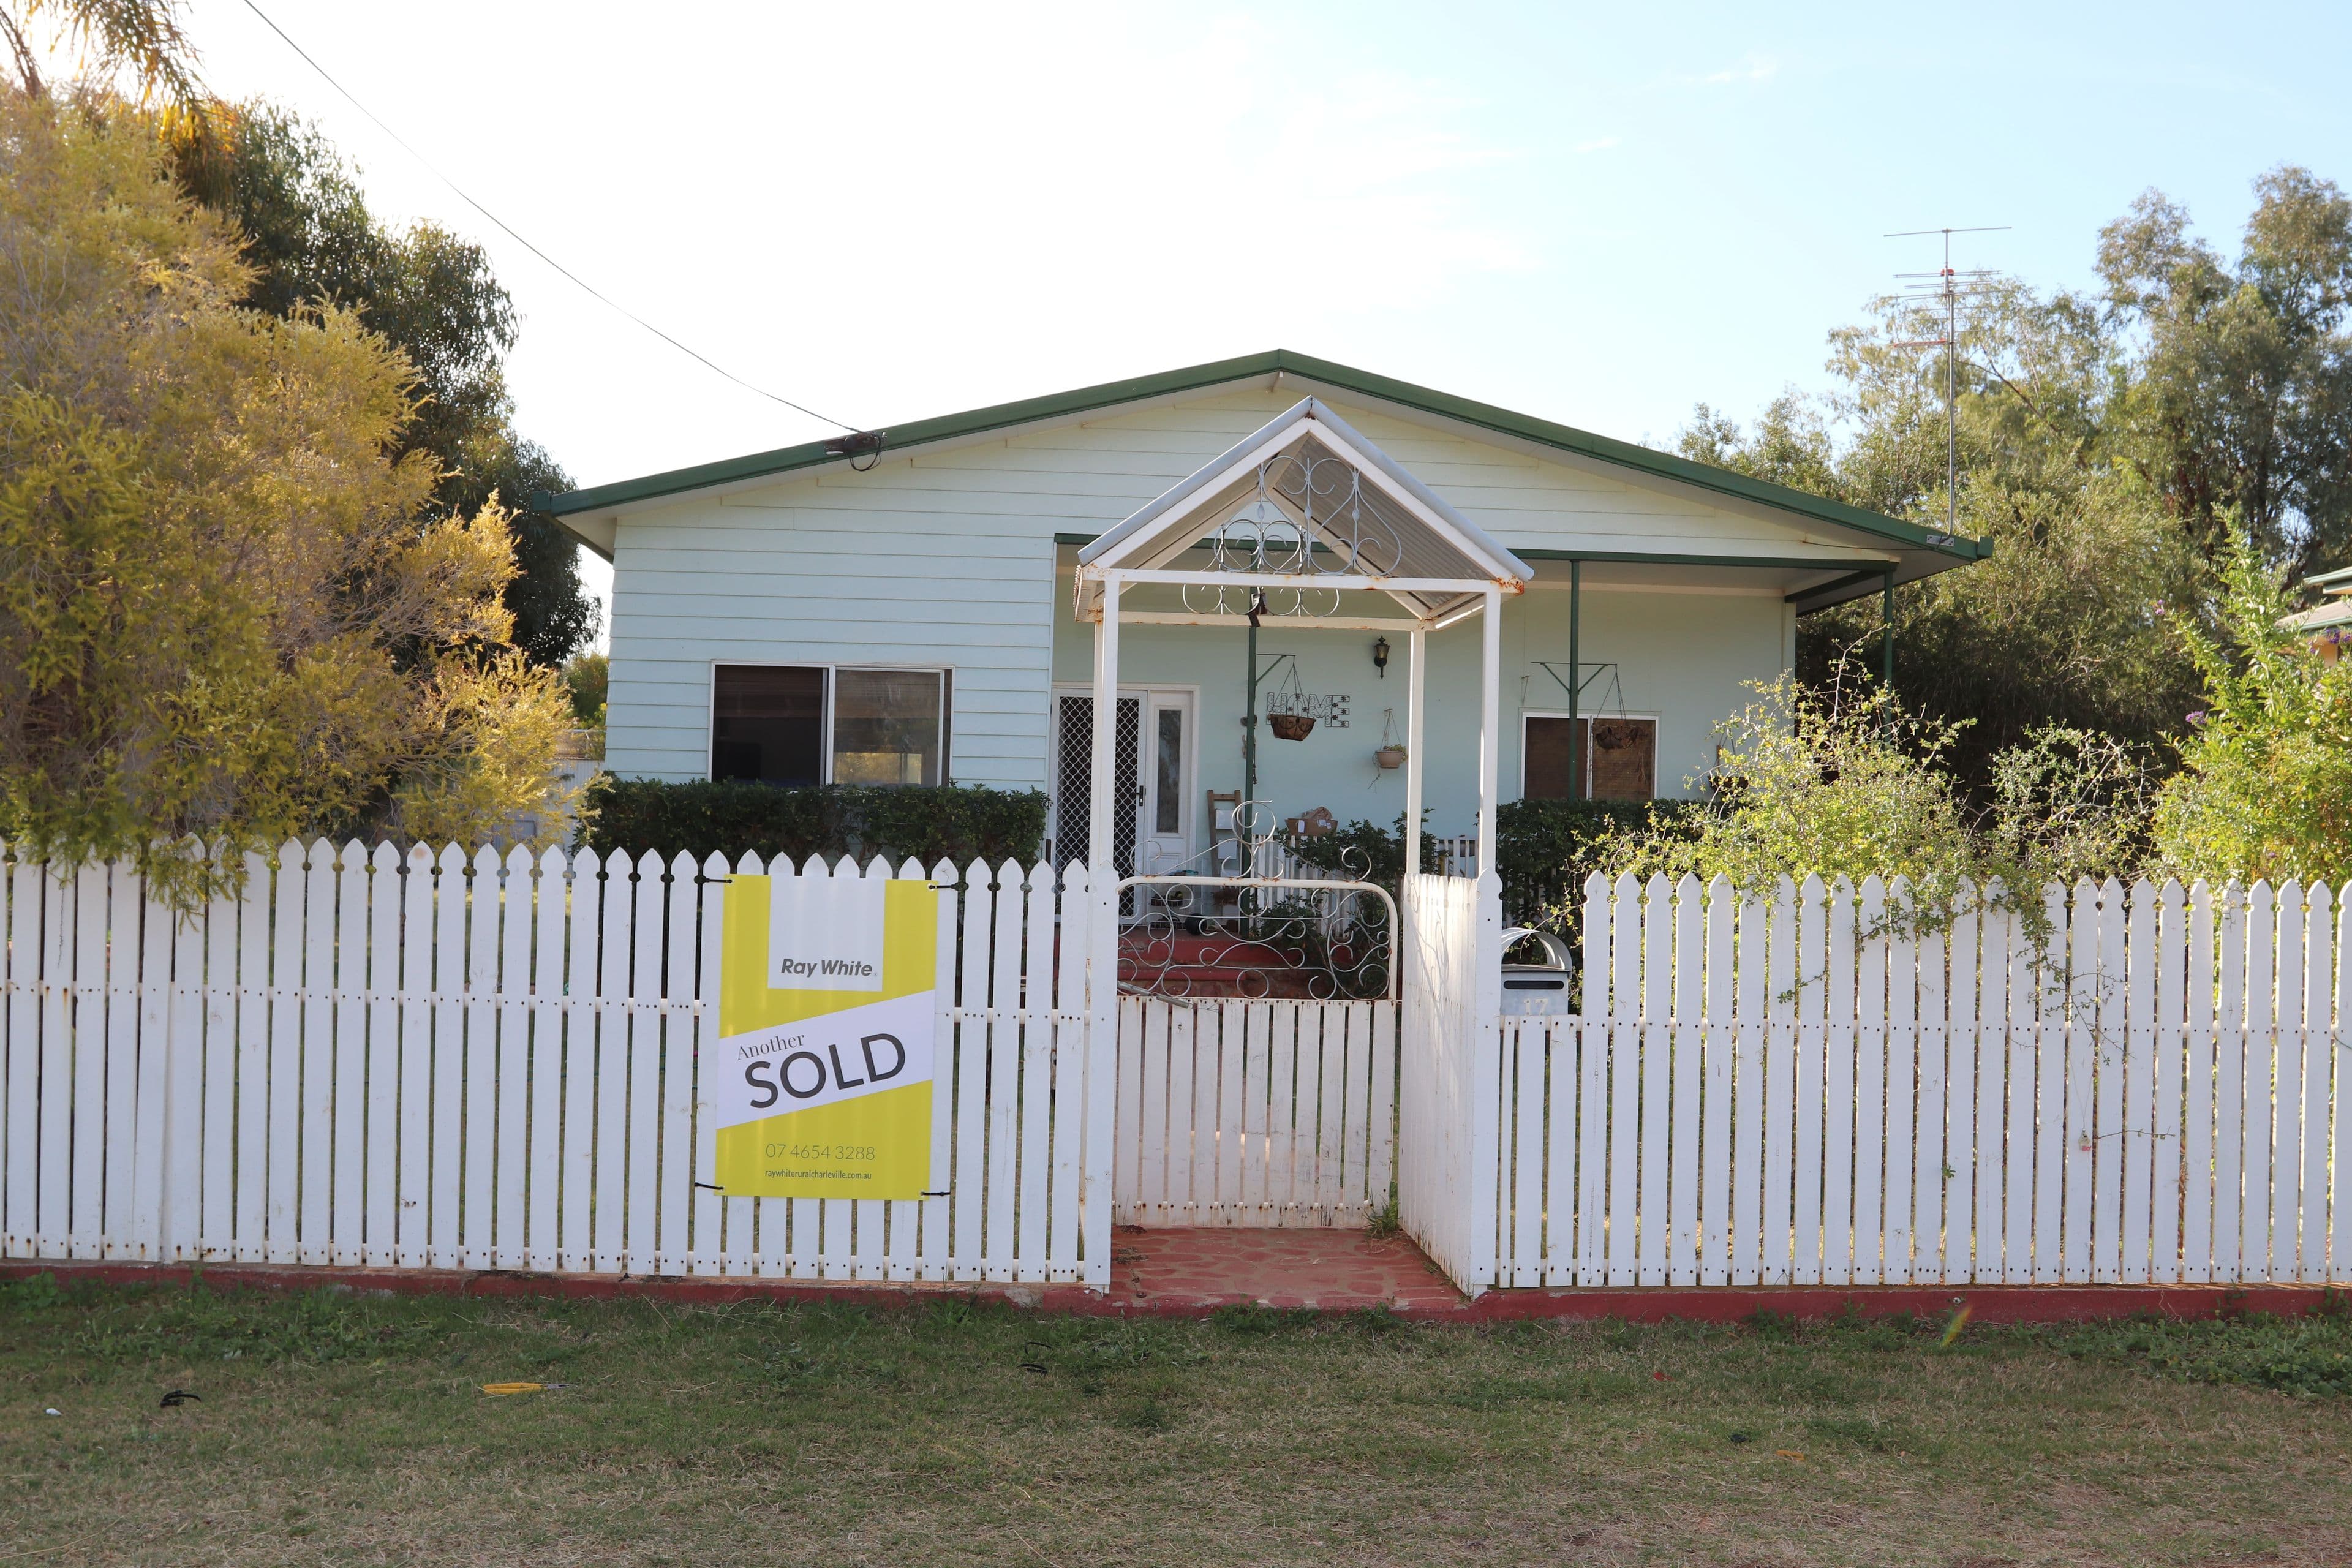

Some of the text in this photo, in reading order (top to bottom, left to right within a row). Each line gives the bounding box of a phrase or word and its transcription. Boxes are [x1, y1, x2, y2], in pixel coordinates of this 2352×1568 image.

[1265, 692, 1350, 728] HOME
[781, 958, 817, 978] Ray
[1523, 998, 1548, 1016] 17
[737, 1034, 805, 1060] Another
[745, 1033, 906, 1109] SOLD
[766, 1144, 875, 1161] 07 4654 3288
[765, 1169, 872, 1180] raywhiteruralcharleville.com.au
